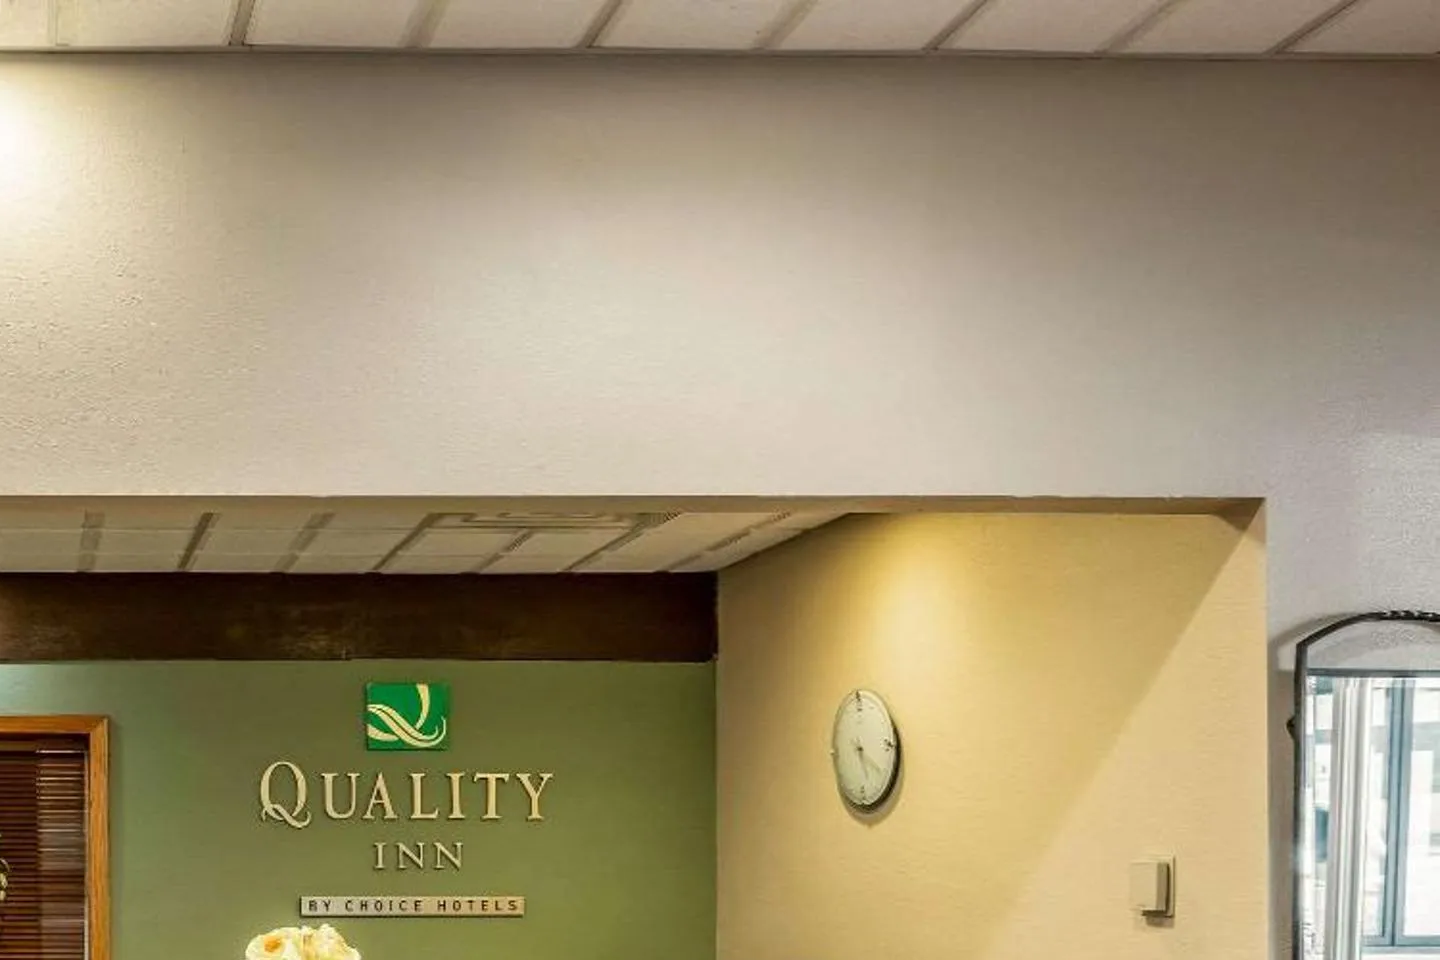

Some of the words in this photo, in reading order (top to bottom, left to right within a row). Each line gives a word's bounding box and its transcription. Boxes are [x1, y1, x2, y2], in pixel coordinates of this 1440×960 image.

[260, 761, 554, 829] QUALITY
[373, 842, 464, 870] INN
[307, 900, 331, 912] BY
[345, 900, 424, 912] CHOICE
[436, 900, 520, 912] HOTELS
